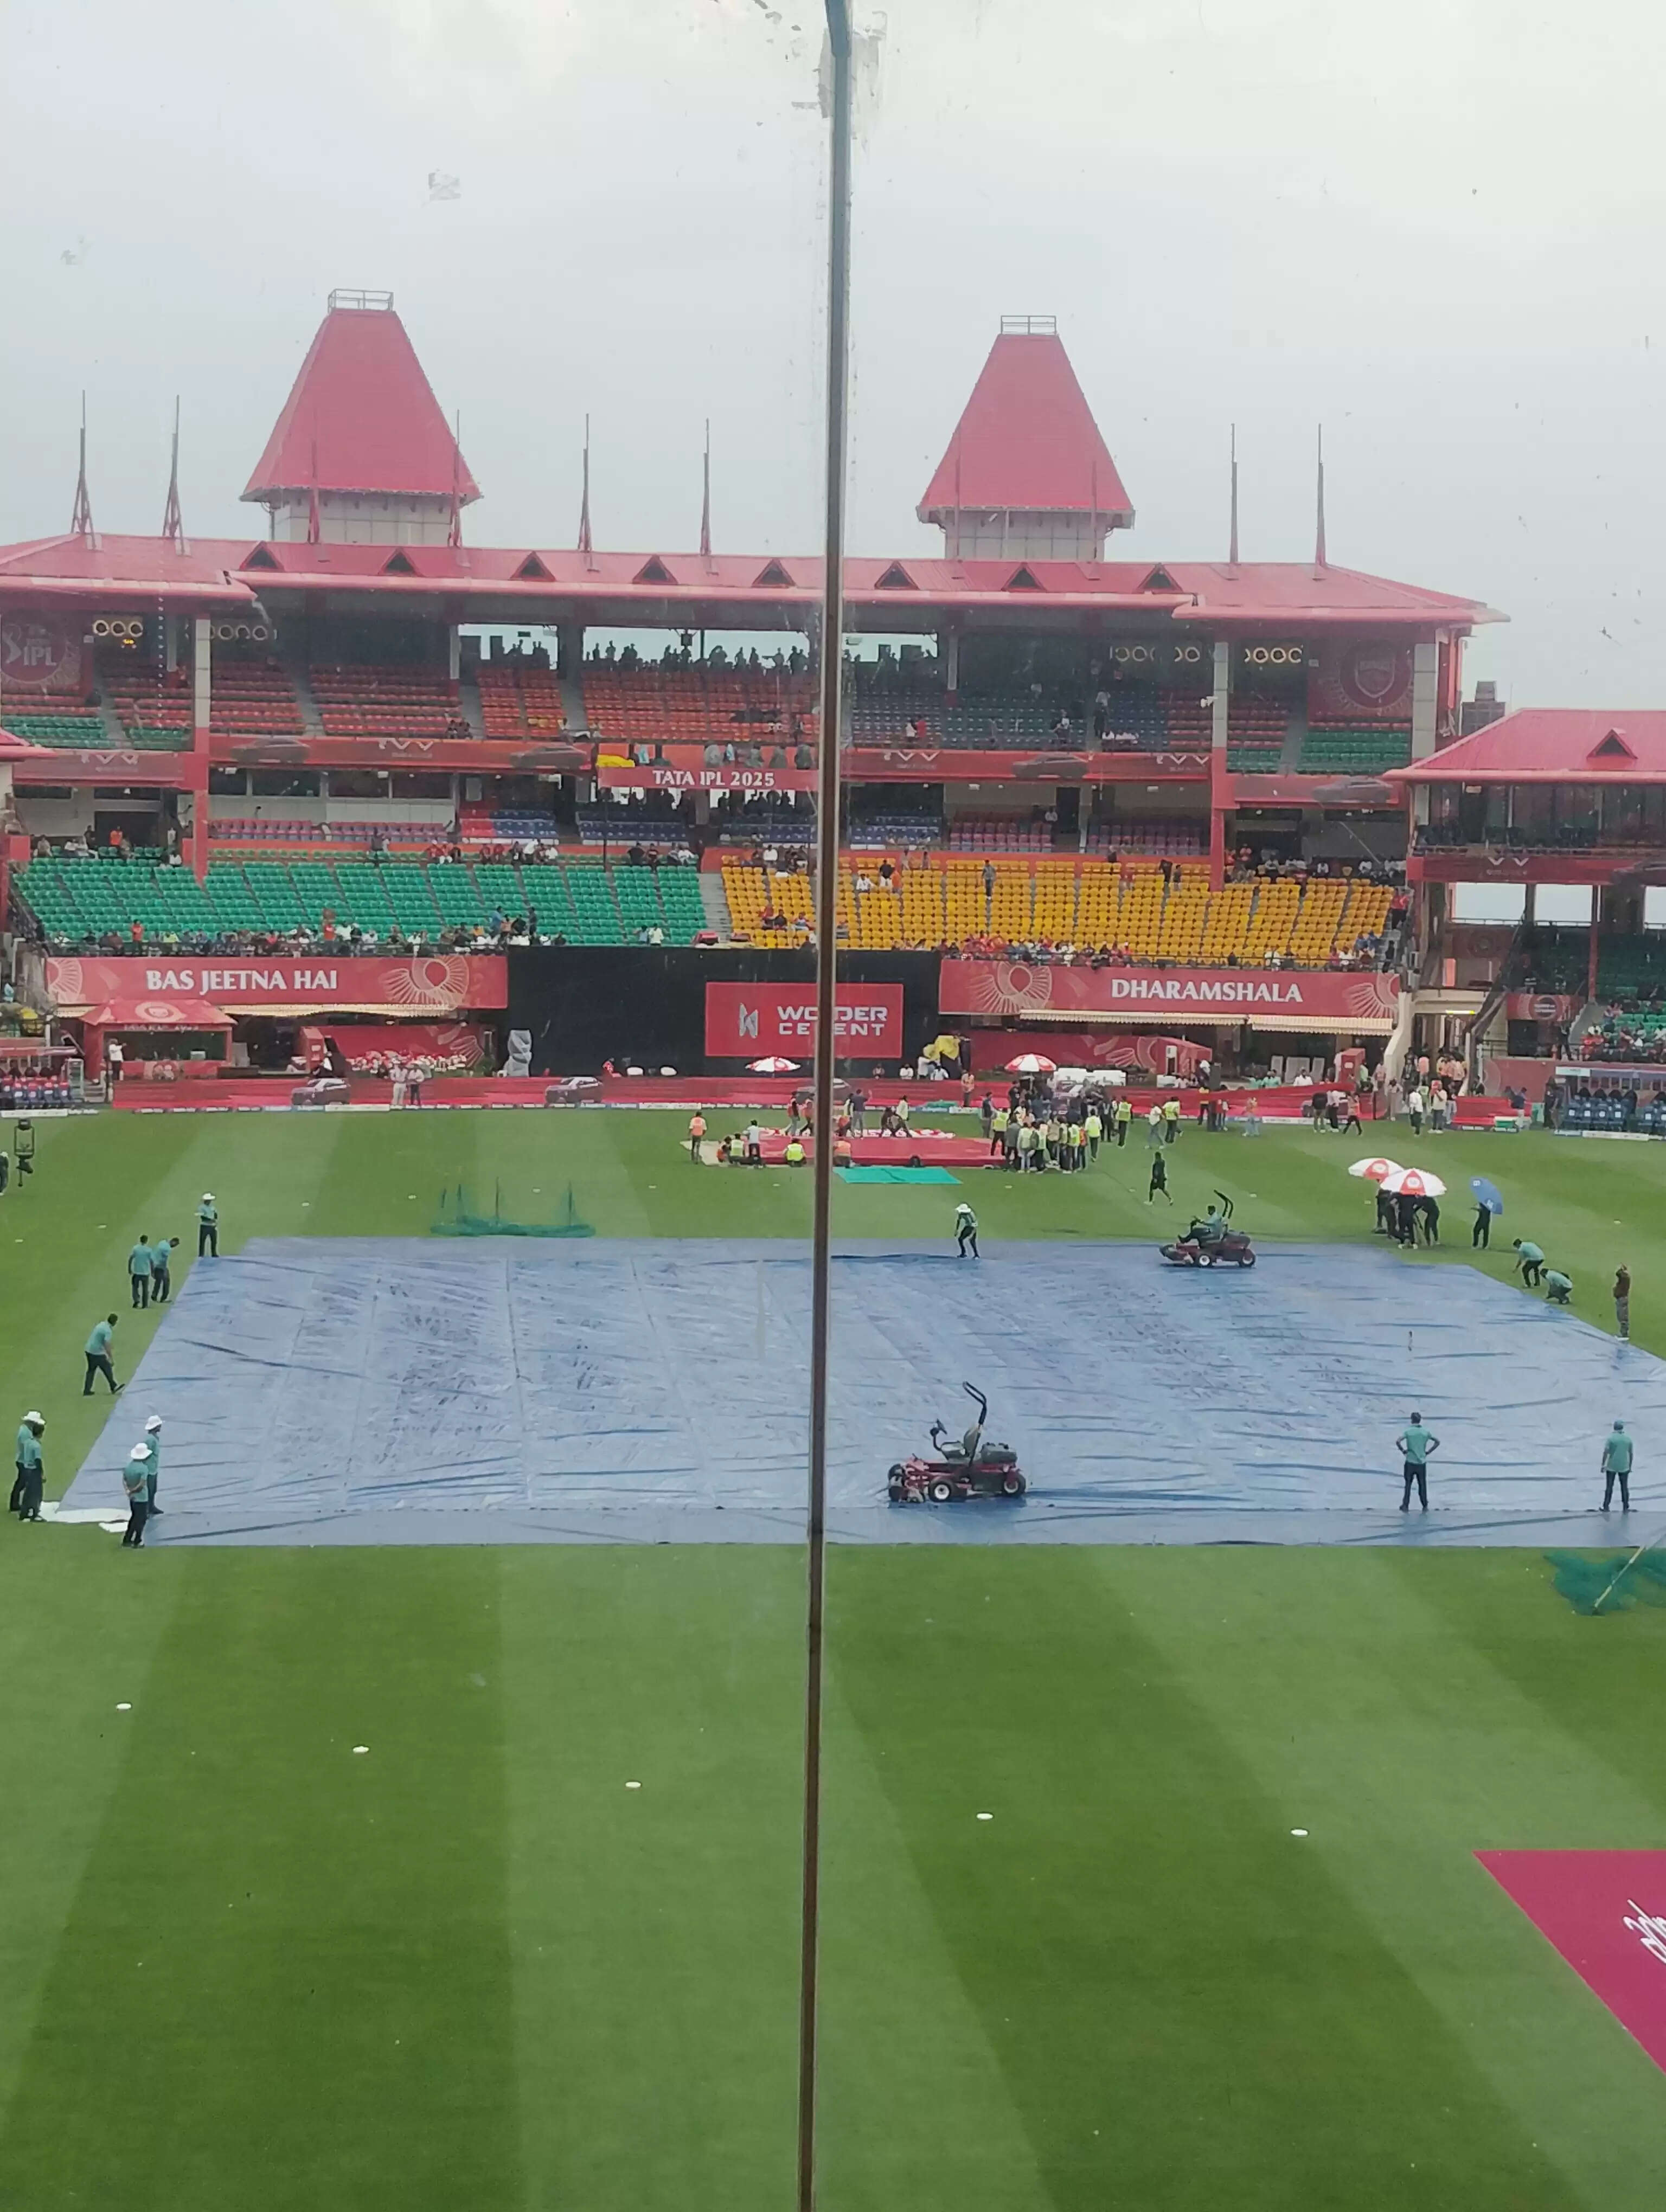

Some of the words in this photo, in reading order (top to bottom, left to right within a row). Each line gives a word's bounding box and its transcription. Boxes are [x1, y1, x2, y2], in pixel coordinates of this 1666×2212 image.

[24, 646, 57, 666] IPL
[652, 770, 695, 786] TATA
[700, 771, 725, 786] IPL
[731, 771, 774, 787] 2025
[146, 970, 194, 990] BAS
[199, 970, 287, 996] JEETNA
[294, 970, 337, 990] HAI
[1112, 979, 1303, 1002] DHARAMSHALA
[777, 1006, 888, 1021] WODER
[779, 1023, 885, 1036] CEENT
